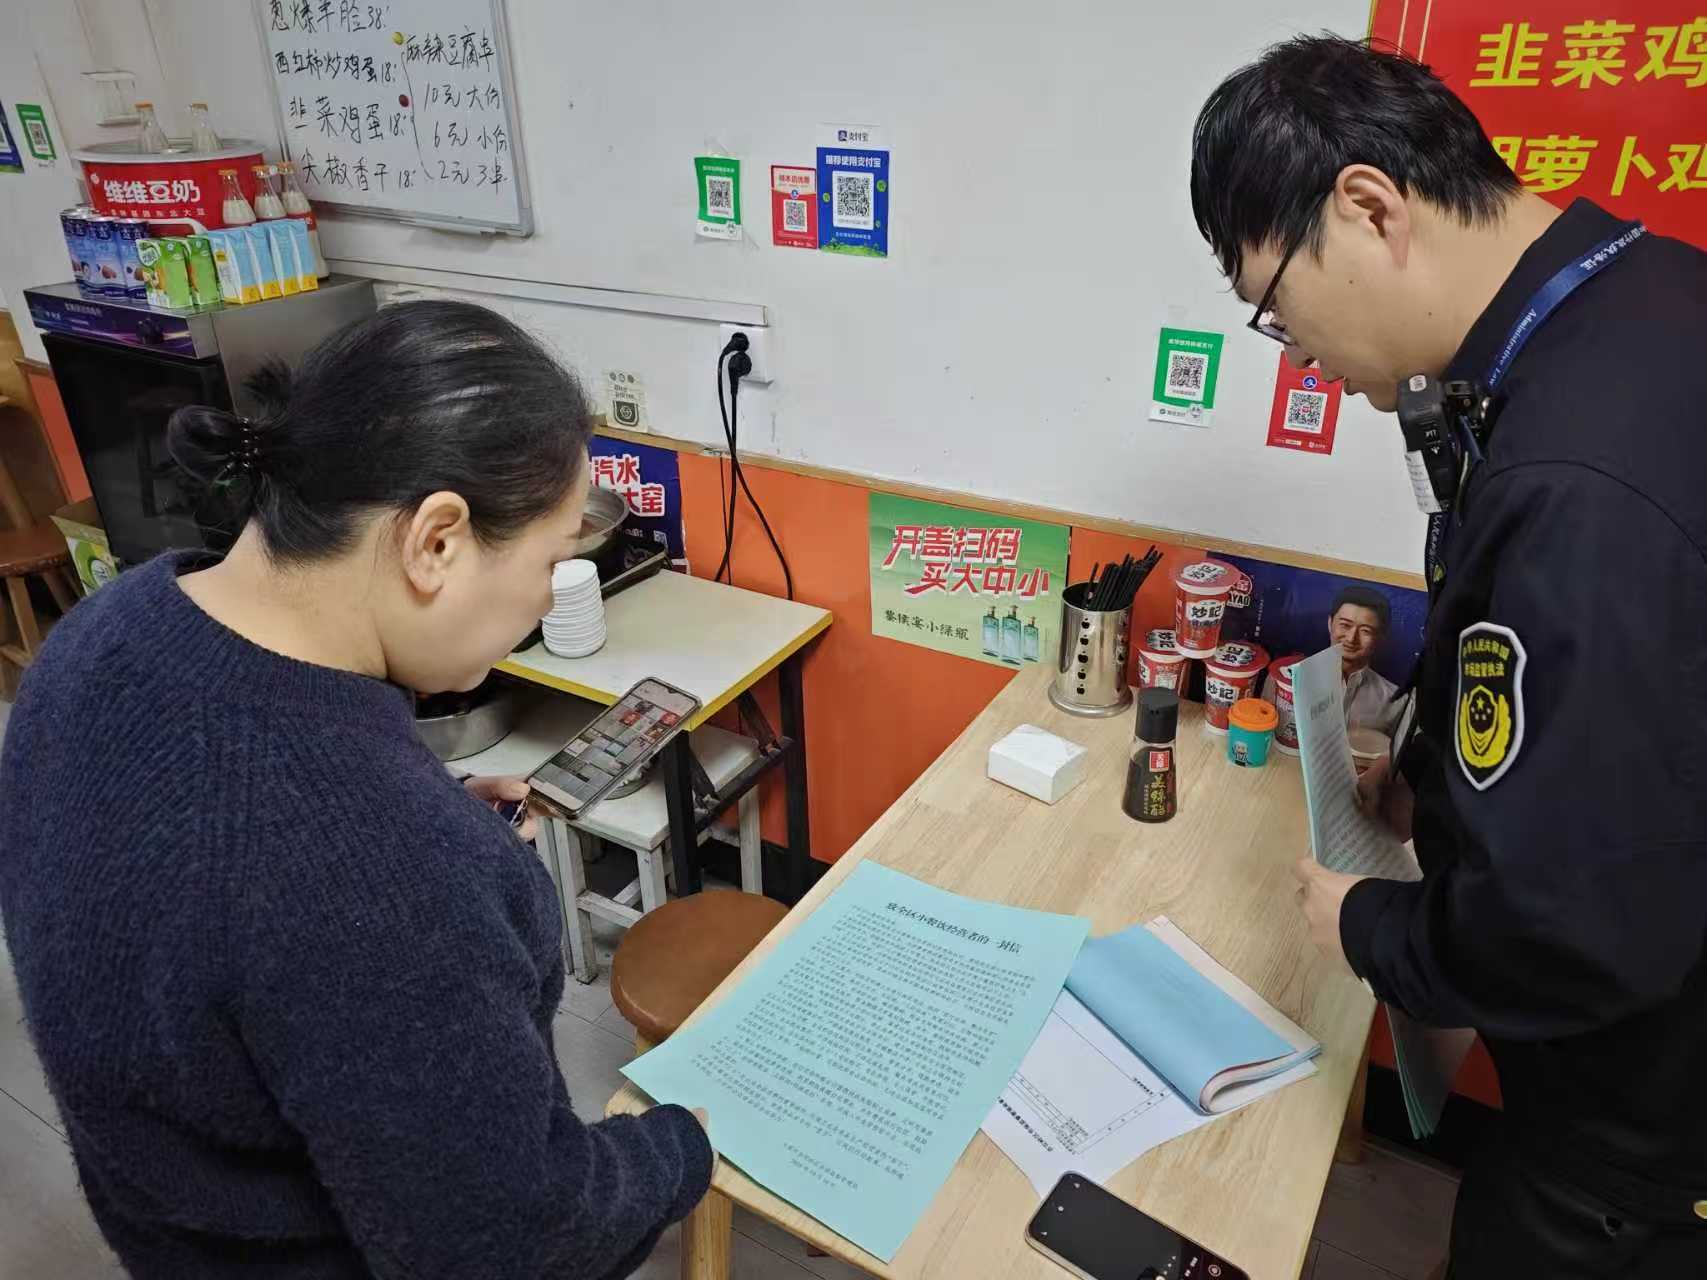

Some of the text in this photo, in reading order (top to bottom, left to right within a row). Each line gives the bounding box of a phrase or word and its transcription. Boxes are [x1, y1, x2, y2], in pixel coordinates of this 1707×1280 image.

[1469, 16, 1707, 88] 韭菜鸡
[103, 179, 201, 203] 维维豆奶
[594, 457, 640, 487] 汽水
[883, 525, 1021, 567] 开盖扫码
[904, 562, 1050, 598] 买大中小
